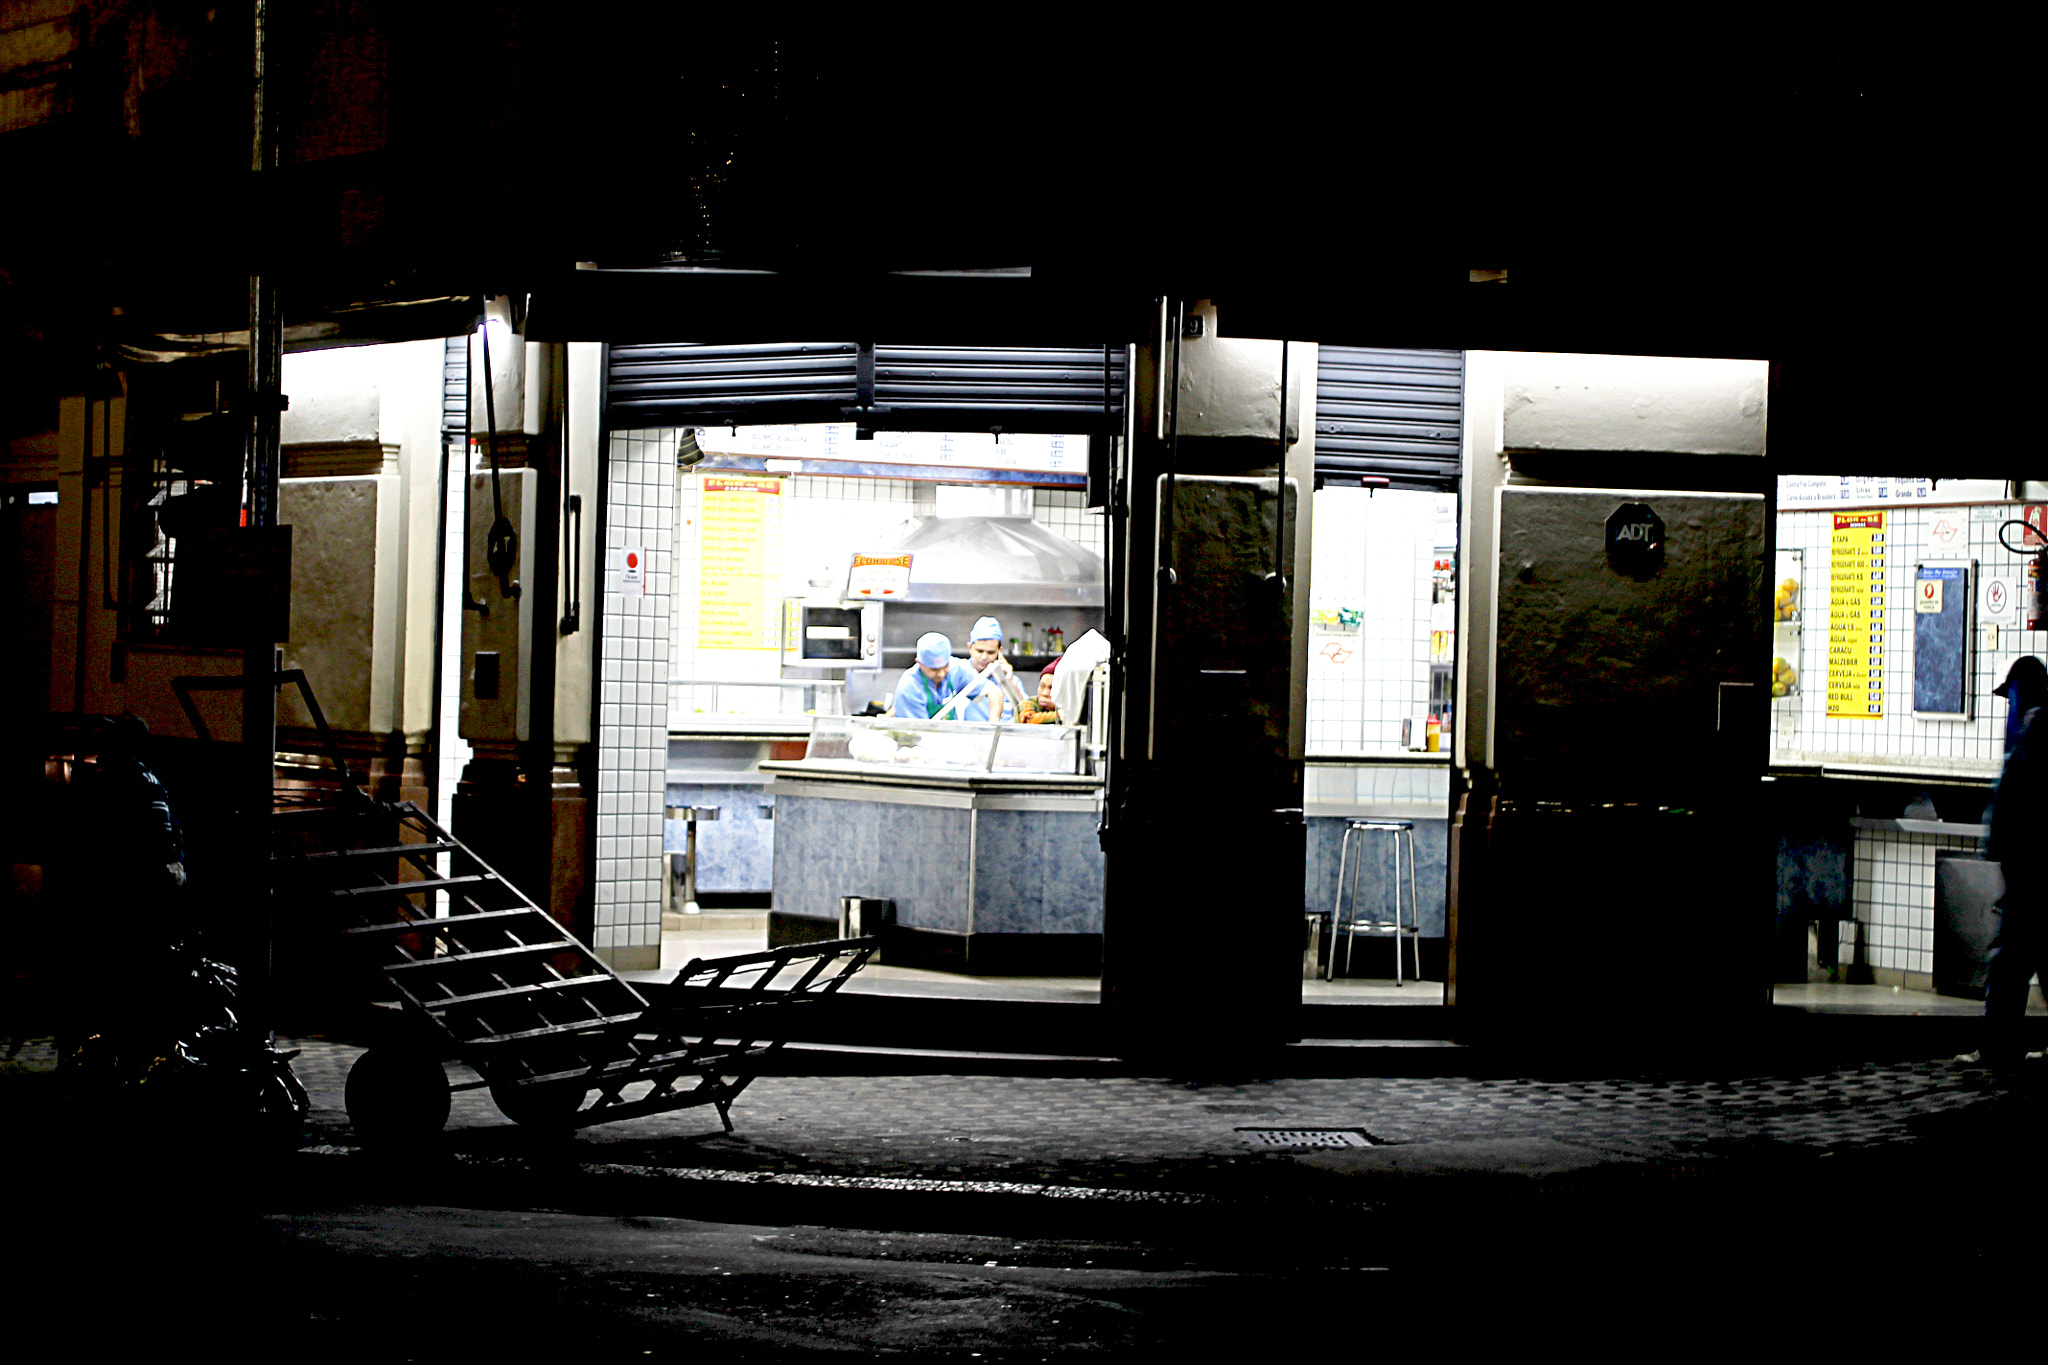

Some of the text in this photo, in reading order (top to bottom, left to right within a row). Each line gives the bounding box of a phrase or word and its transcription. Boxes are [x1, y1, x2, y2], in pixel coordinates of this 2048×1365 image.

[1616, 523, 1653, 542] ADT
[853, 556, 879, 565] FLOR
[1831, 560, 1855, 568] REFRIGERANTE
[1829, 669, 1852, 677] CERVEJA
[1828, 681, 1851, 689] CERVEJA
[1840, 693, 1853, 701] BULL
